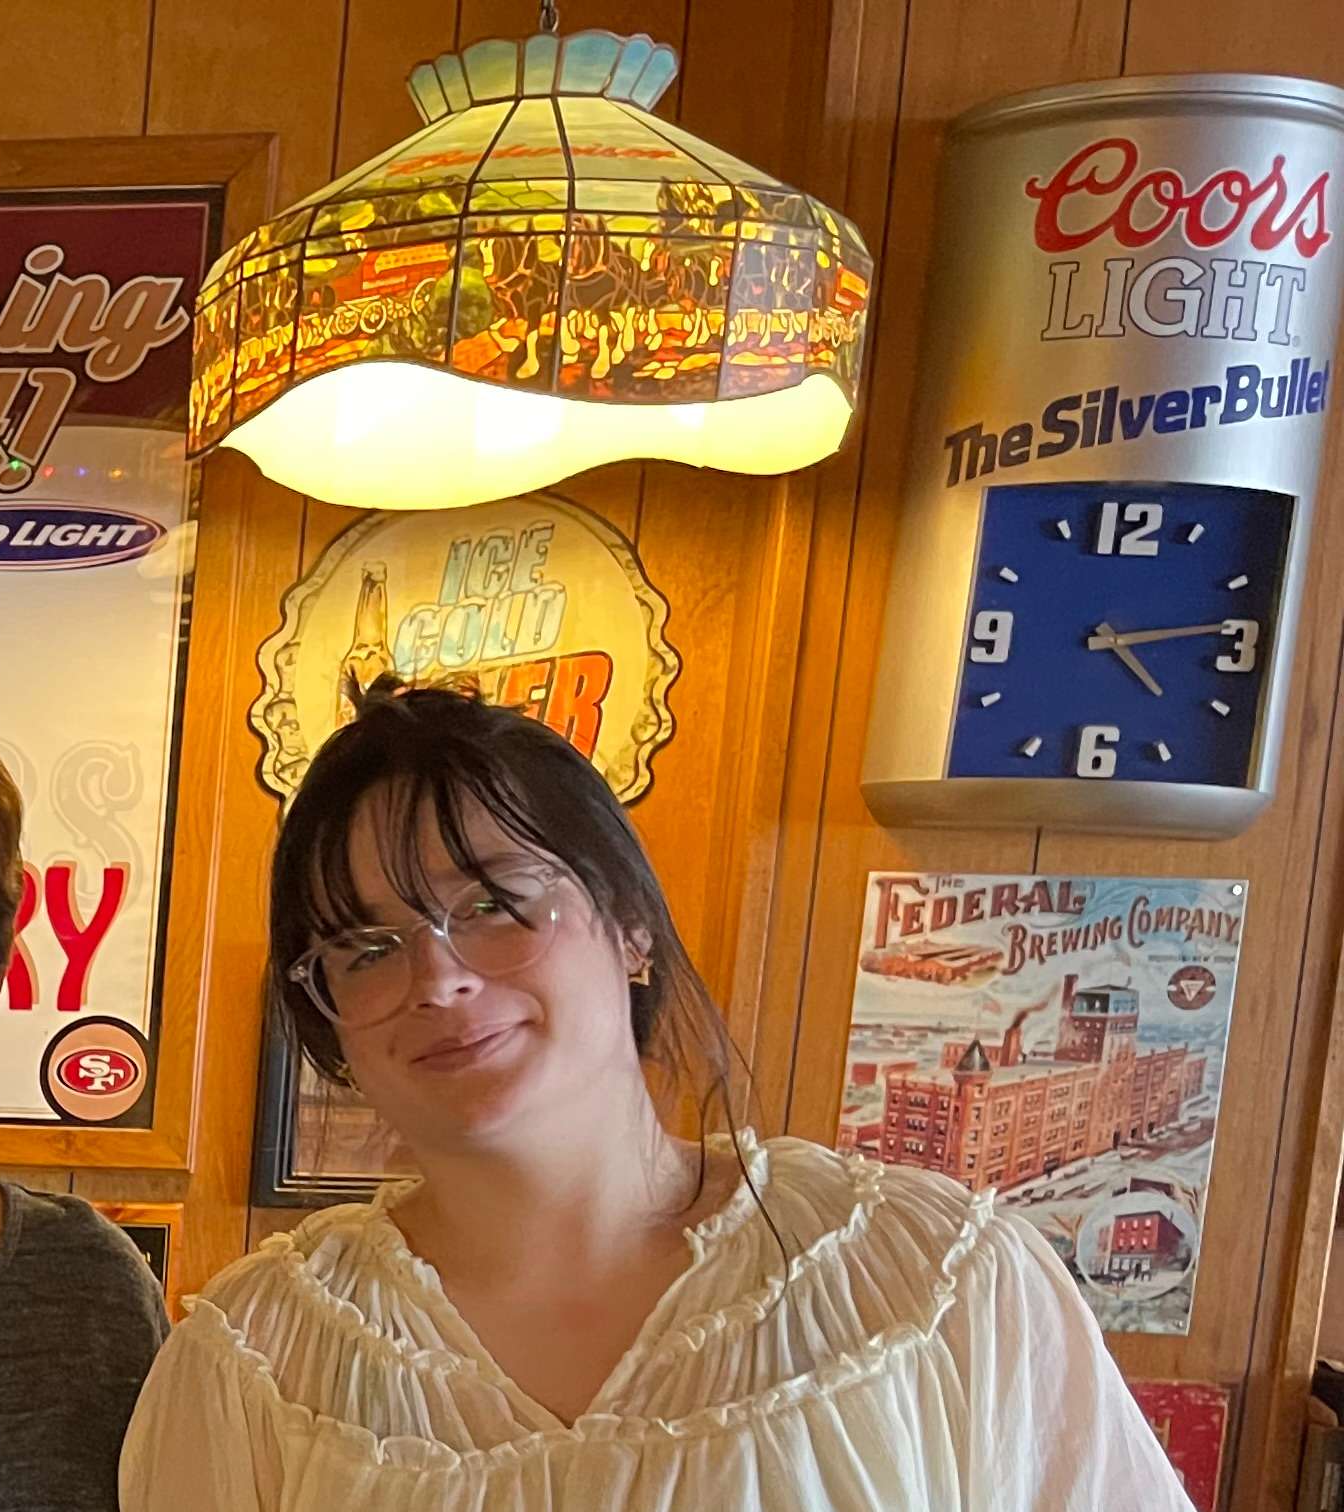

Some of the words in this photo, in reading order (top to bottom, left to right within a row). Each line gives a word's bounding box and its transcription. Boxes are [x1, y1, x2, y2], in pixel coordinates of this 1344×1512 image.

[1024, 138, 1332, 258] Coors
[1041, 256, 1306, 347] LIGHT
[943, 421, 1034, 489] The
[1037, 385, 1222, 460] Silver
[1218, 357, 1331, 426] Bullet
[15, 519, 147, 548] LIGHT
[1096, 502, 1163, 556] 12
[438, 520, 556, 607] ICE
[393, 581, 568, 675] COLD
[970, 610, 1014, 663] 9
[1215, 619, 1260, 673] 3
[478, 650, 614, 760] ER
[1076, 725, 1120, 778] 6
[874, 877, 1086, 949] FEDERAL
[1001, 915, 1122, 976] BREWING
[78, 1054, 125, 1091] SF
